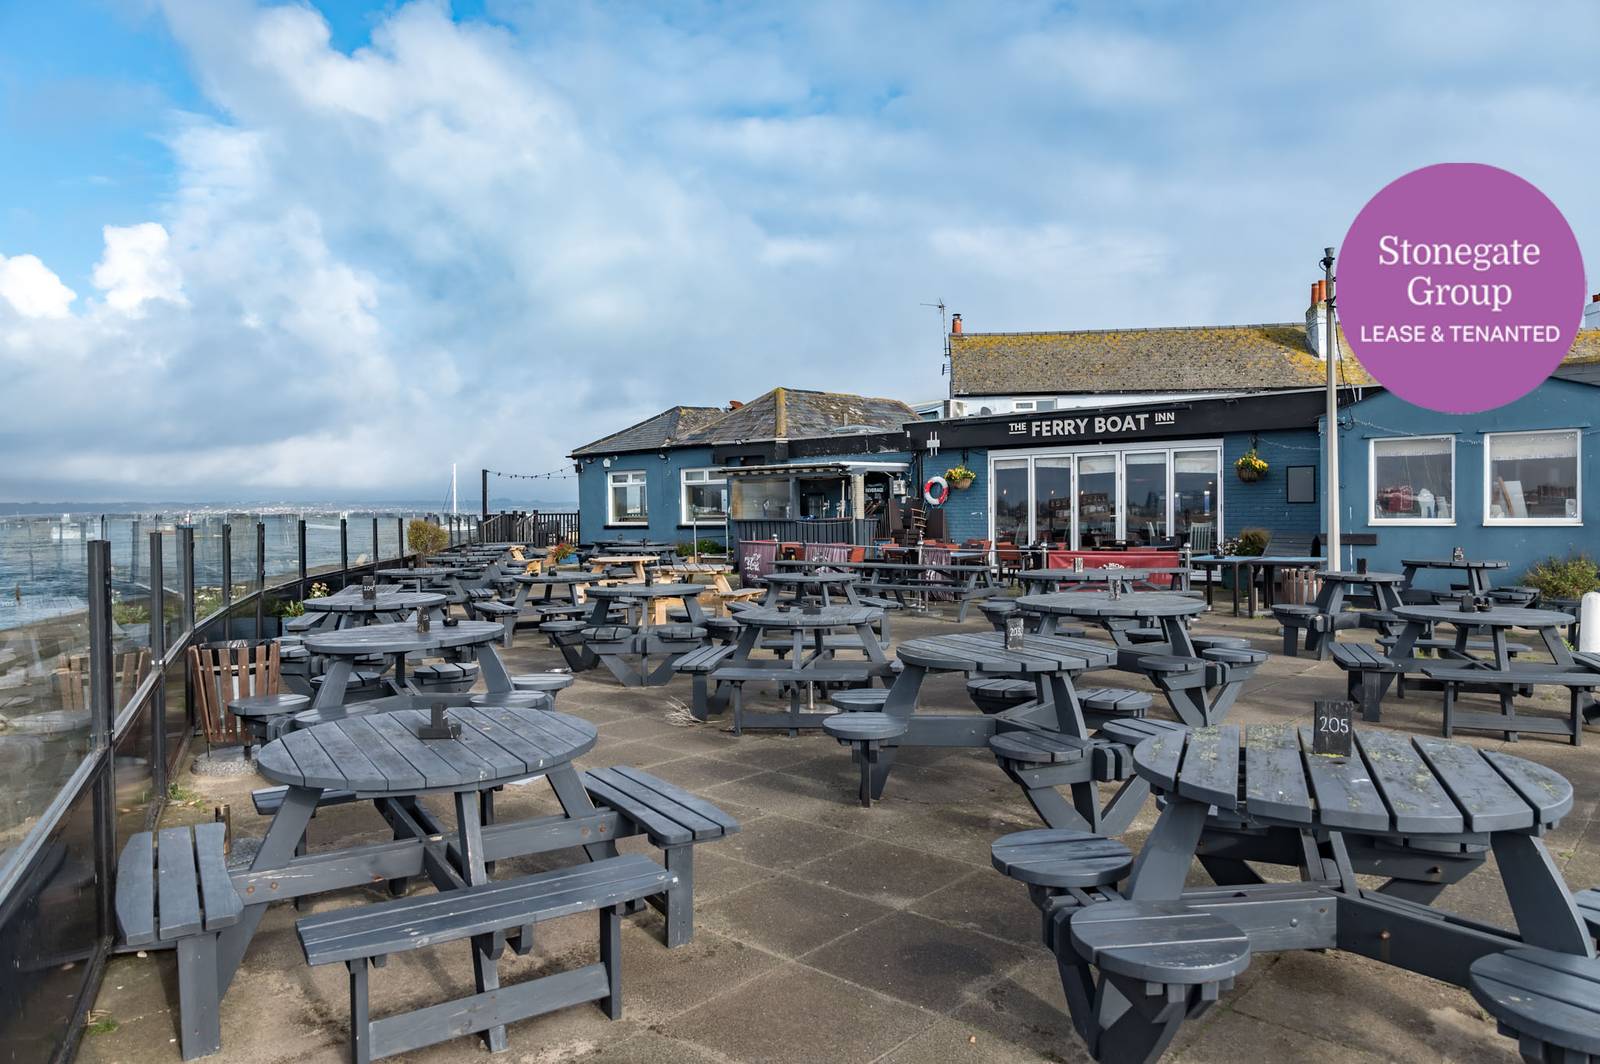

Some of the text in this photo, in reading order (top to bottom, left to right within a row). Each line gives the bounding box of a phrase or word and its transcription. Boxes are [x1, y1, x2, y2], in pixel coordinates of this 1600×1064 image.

[1009, 412, 1175, 437] THE FERRY BOAT INN
[1319, 716, 1349, 733] 205
